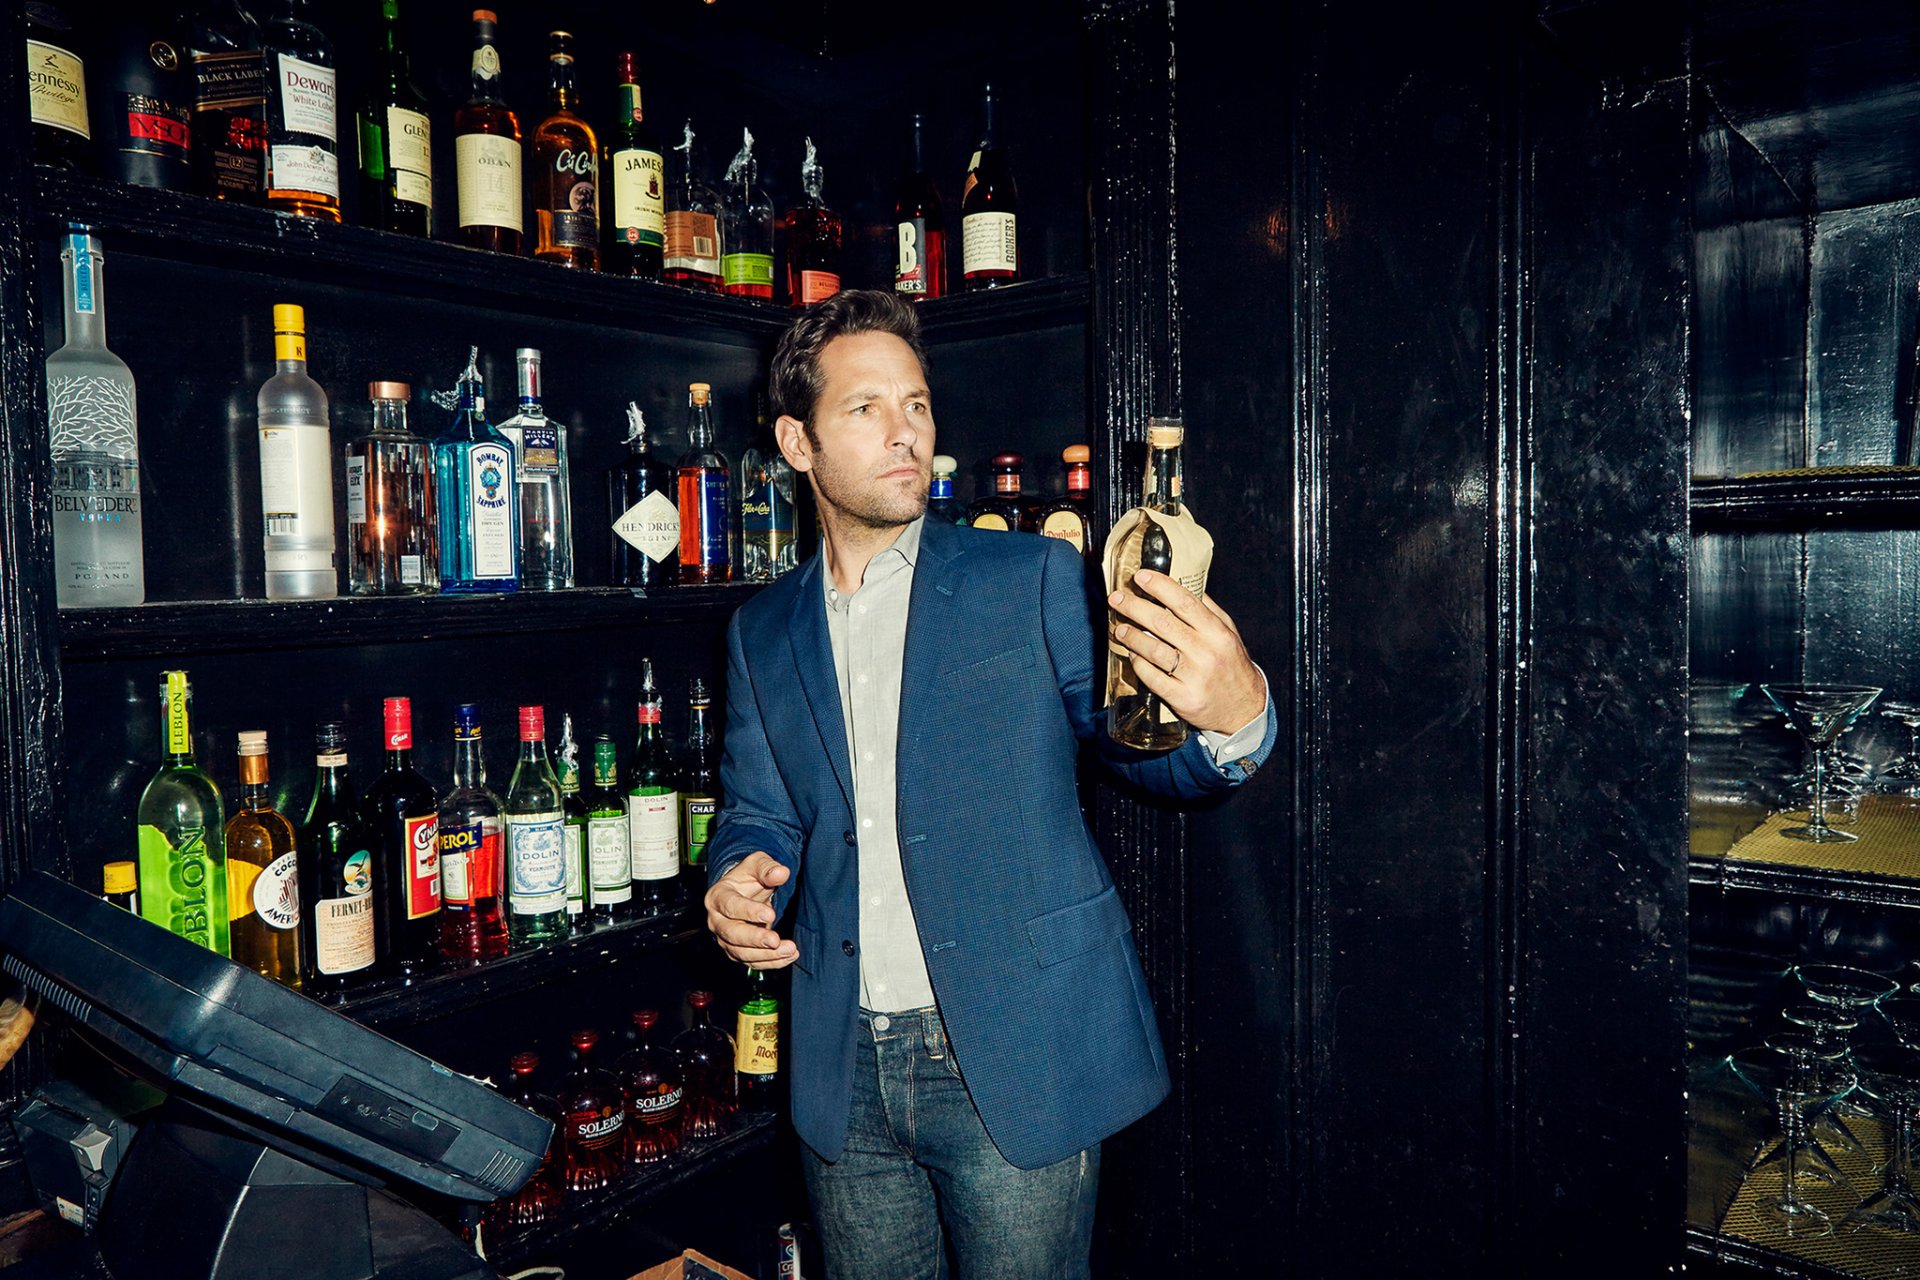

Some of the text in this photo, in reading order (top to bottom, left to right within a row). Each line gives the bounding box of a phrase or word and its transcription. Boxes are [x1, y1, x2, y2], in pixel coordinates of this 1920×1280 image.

[28, 70, 81, 98] ennessy
[197, 69, 266, 84] BLACK LABEL
[478, 157, 513, 169] OBAN
[625, 159, 664, 179] JAMES
[895, 278, 922, 291] AKER'S
[475, 452, 504, 467] BOMBAY
[475, 494, 507, 509] SAPPHIRE
[79, 513, 121, 522] VODKA
[173, 691, 184, 747] LEBLON
[691, 804, 716, 814] CHAR
[522, 849, 560, 860] DOLIN
[635, 1087, 684, 1110] SOLERNO
[578, 1109, 626, 1136] SOLERNO
